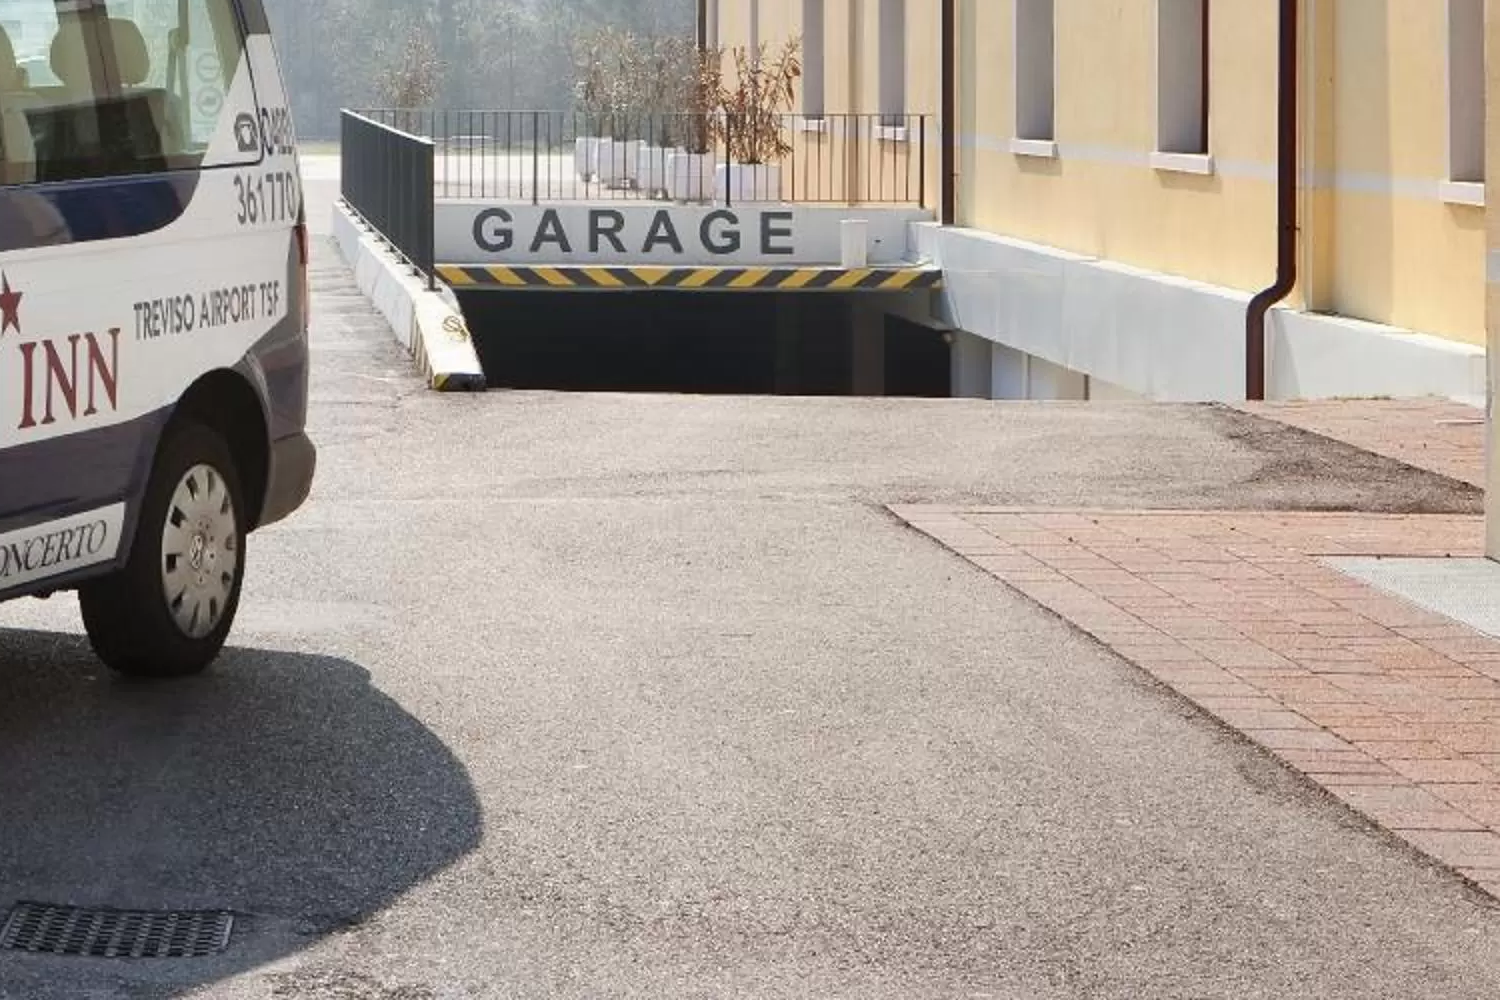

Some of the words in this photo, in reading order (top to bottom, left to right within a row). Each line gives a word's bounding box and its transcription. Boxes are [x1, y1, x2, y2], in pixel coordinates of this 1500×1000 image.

[233, 171, 297, 225] 361770
[472, 207, 796, 255] GARAGE
[133, 293, 195, 340] TREVISO
[199, 284, 257, 329] AIRPORT
[260, 280, 280, 317] TSF
[18, 327, 121, 429] INN
